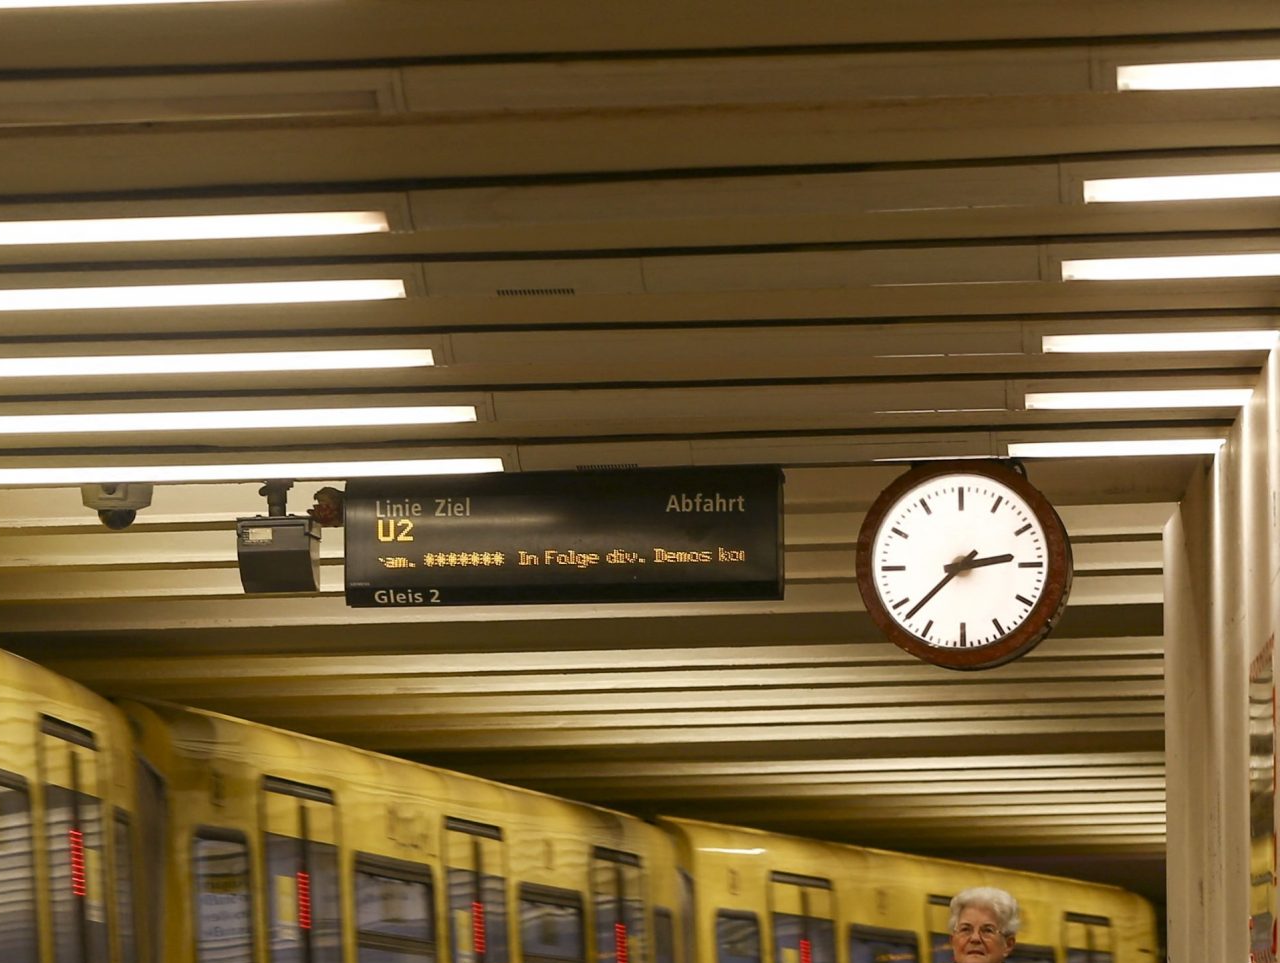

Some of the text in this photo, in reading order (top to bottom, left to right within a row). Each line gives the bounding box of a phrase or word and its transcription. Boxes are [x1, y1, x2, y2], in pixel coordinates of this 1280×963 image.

[376, 497, 471, 518] Linie Ziel
[665, 493, 745, 513] Abfahrt
[377, 519, 414, 542] U2
[518, 550, 539, 566] In
[544, 549, 600, 569] Folge
[605, 548, 646, 565] div.
[653, 547, 713, 563] Demos
[374, 589, 441, 604] Gleis 2
